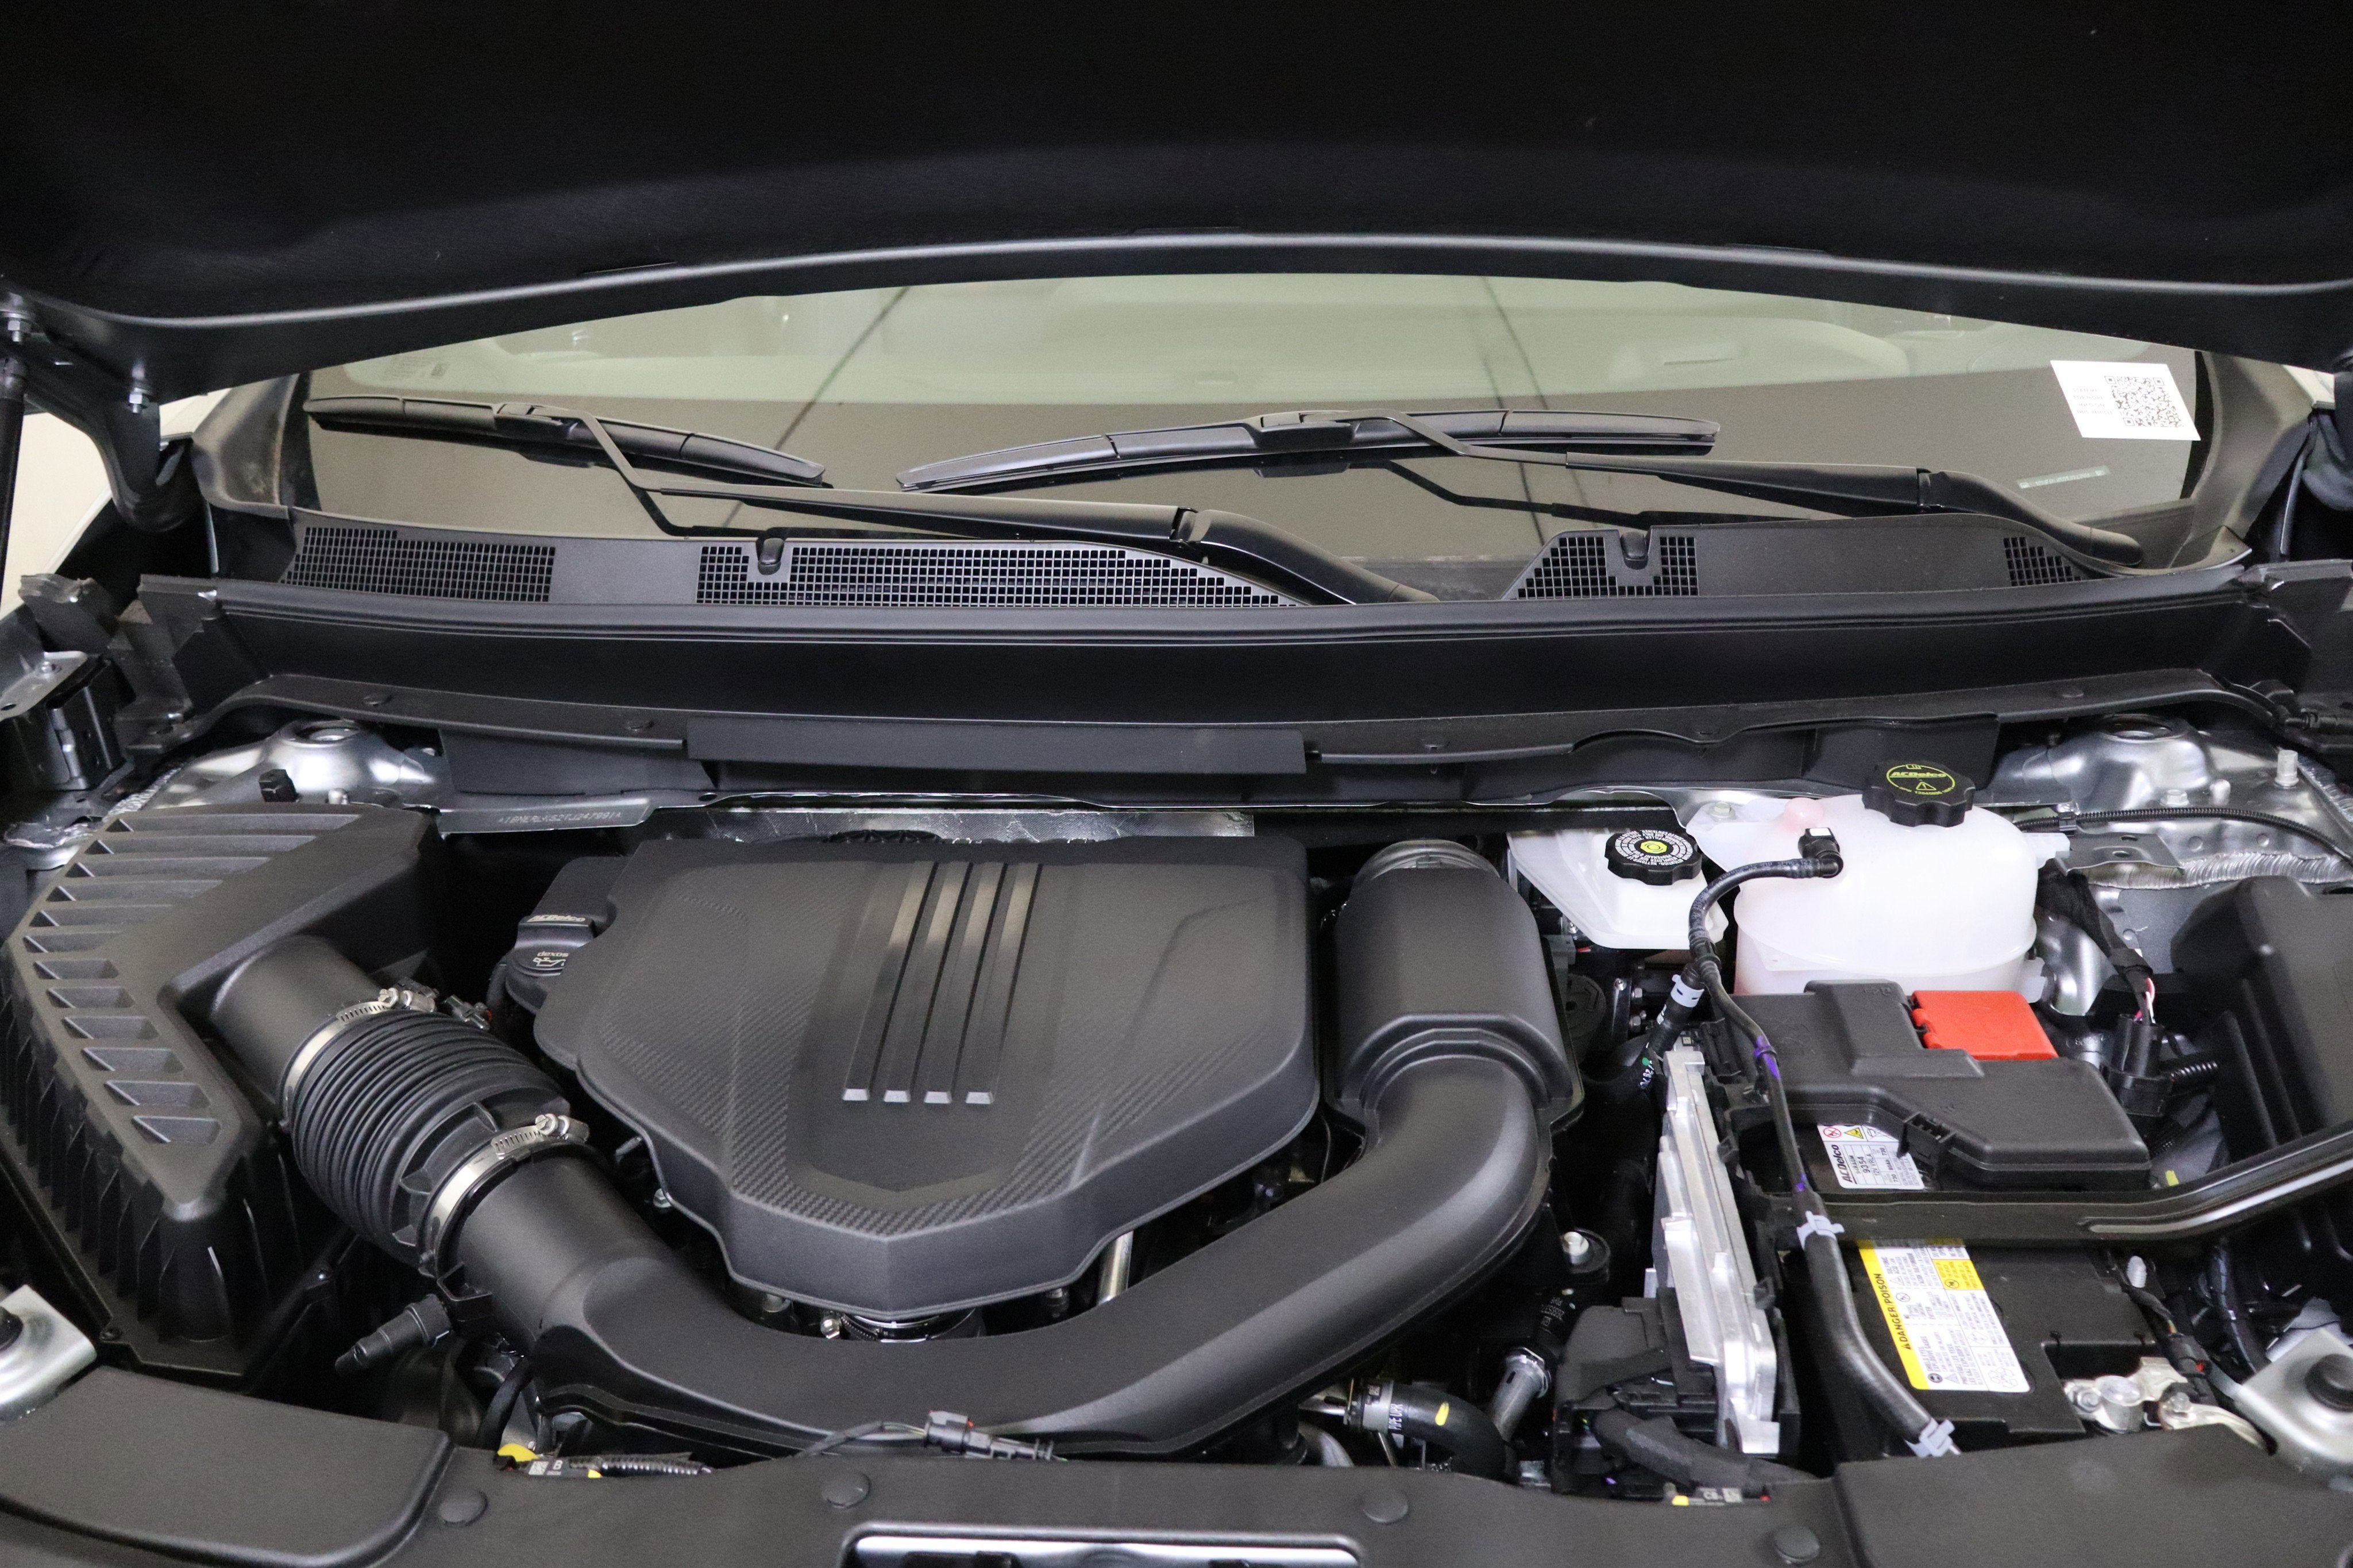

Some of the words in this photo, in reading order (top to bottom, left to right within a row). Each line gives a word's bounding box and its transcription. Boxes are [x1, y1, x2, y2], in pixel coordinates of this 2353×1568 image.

[526, 914, 586, 922] ACDelco
[1831, 1144, 1852, 1182] ACDelco
[1857, 1156, 1870, 1173] 9354
[1874, 1273, 1907, 1342] DANGER/POISON
